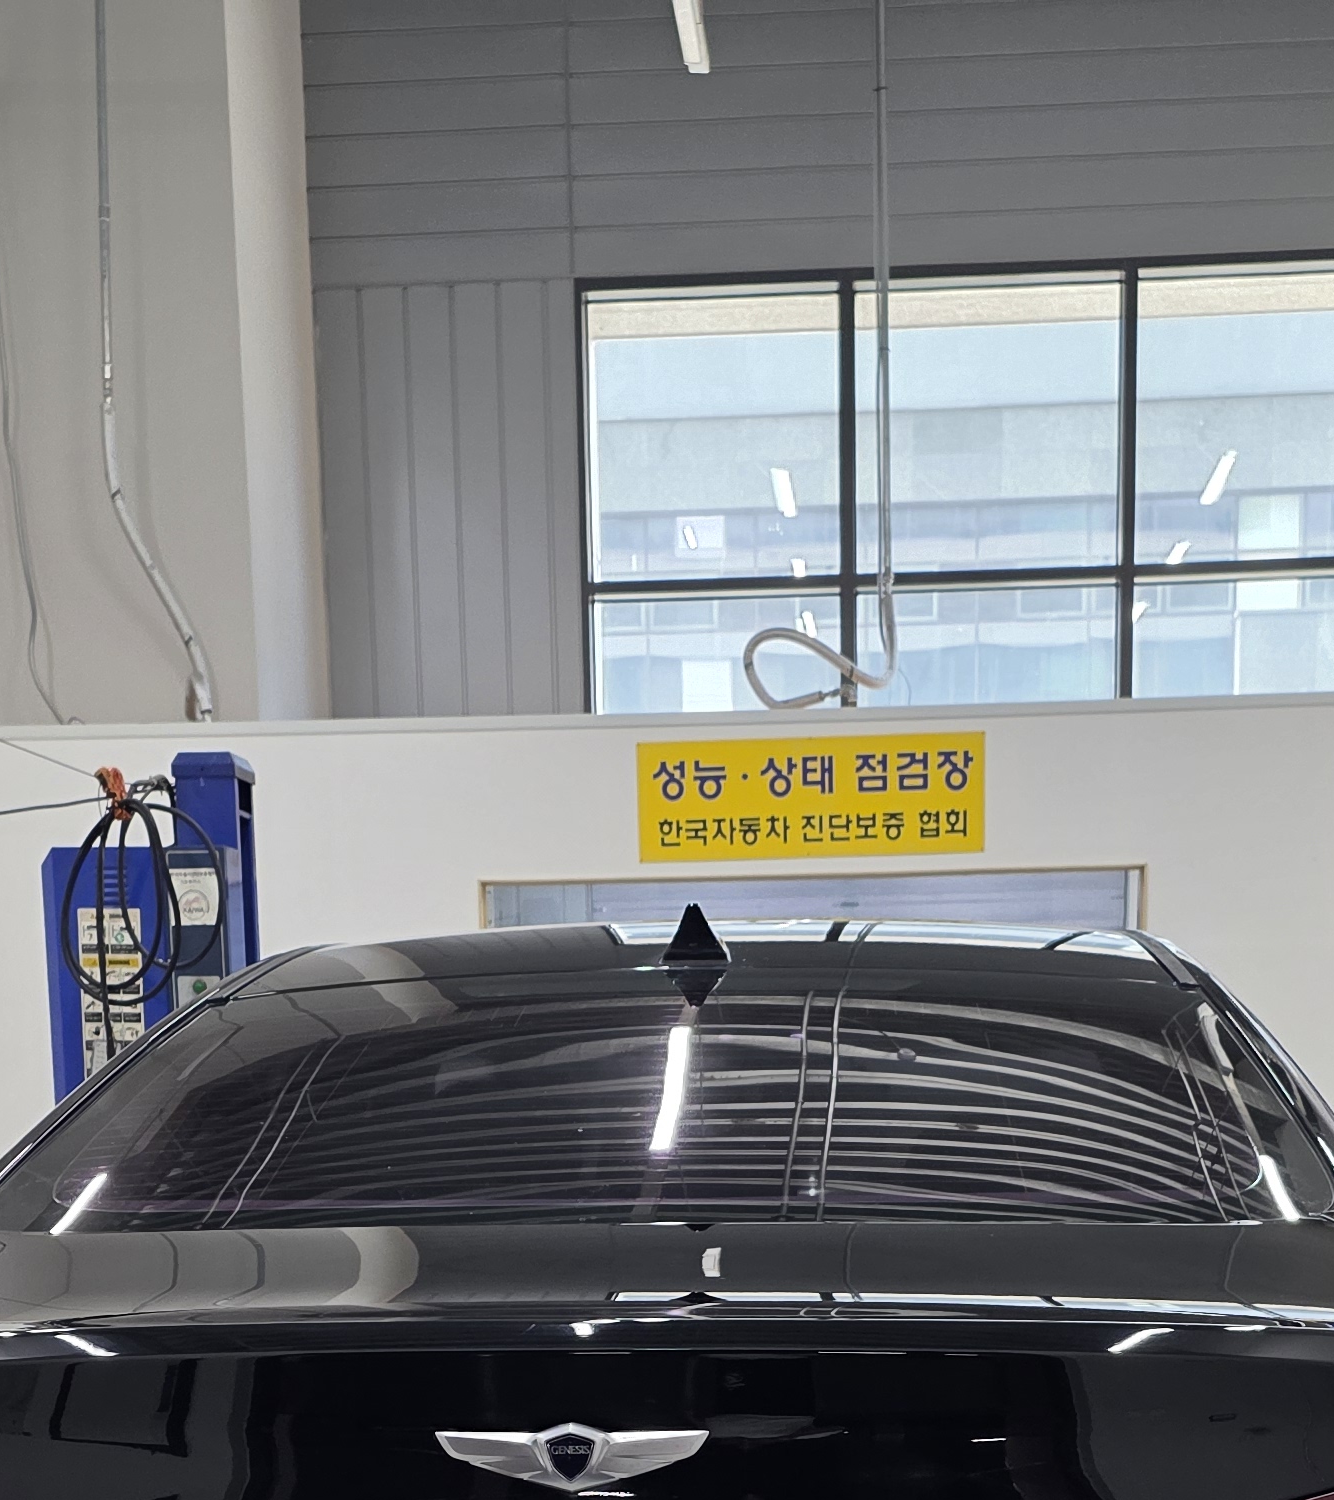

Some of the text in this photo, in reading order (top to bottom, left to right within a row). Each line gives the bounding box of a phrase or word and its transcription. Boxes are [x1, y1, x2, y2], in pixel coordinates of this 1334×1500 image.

[854, 749, 975, 794] 점검장
[658, 808, 969, 848] 한국자동차 진단보증 협회
[551, 1445, 590, 1455] GENESIS
